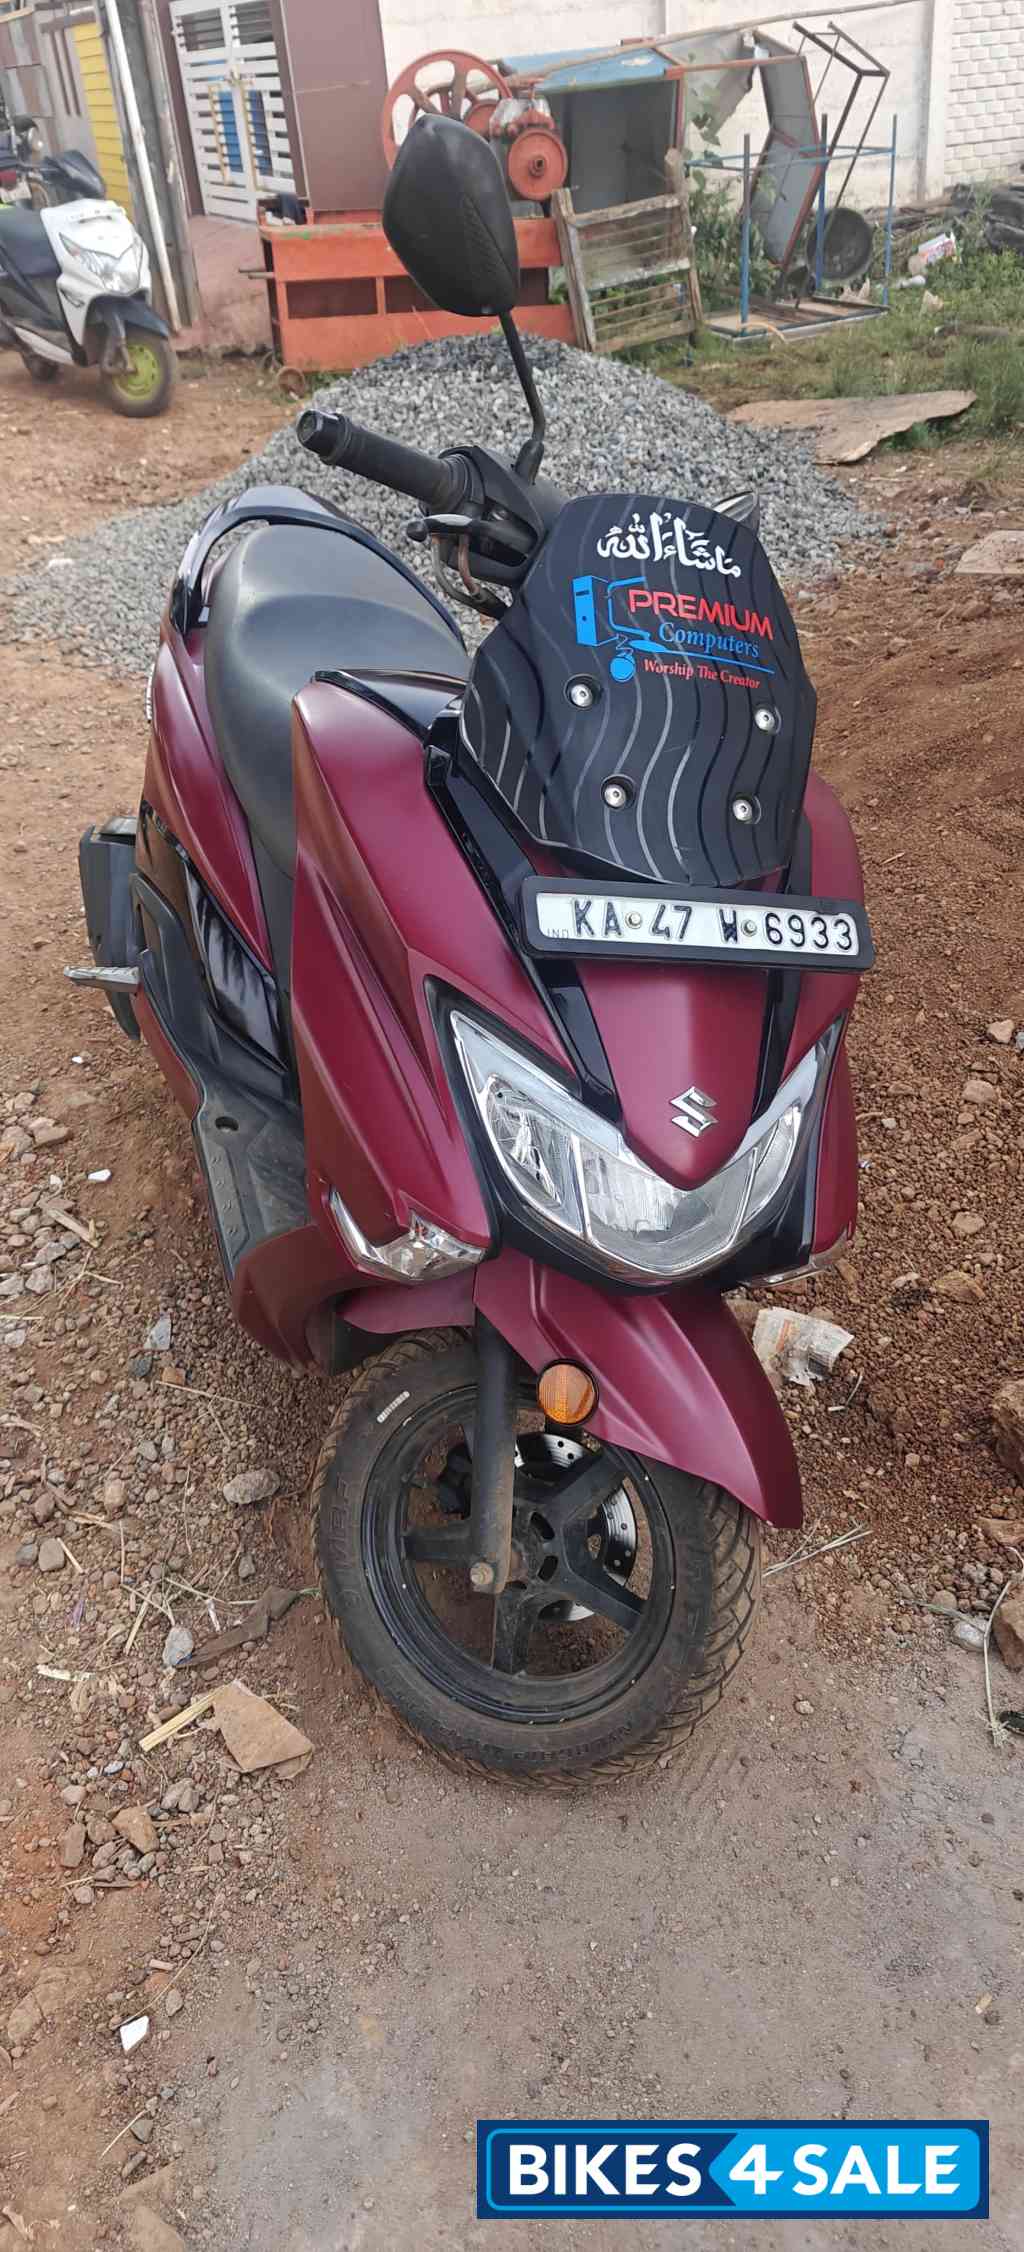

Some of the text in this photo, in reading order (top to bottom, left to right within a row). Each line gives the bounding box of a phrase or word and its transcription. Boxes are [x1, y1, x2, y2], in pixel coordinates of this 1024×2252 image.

[628, 588, 774, 641] PREMIUM
[658, 622, 760, 658] Computers
[643, 658, 761, 690] Worship The Creator
[573, 900, 853, 951] KA 47 W 6933
